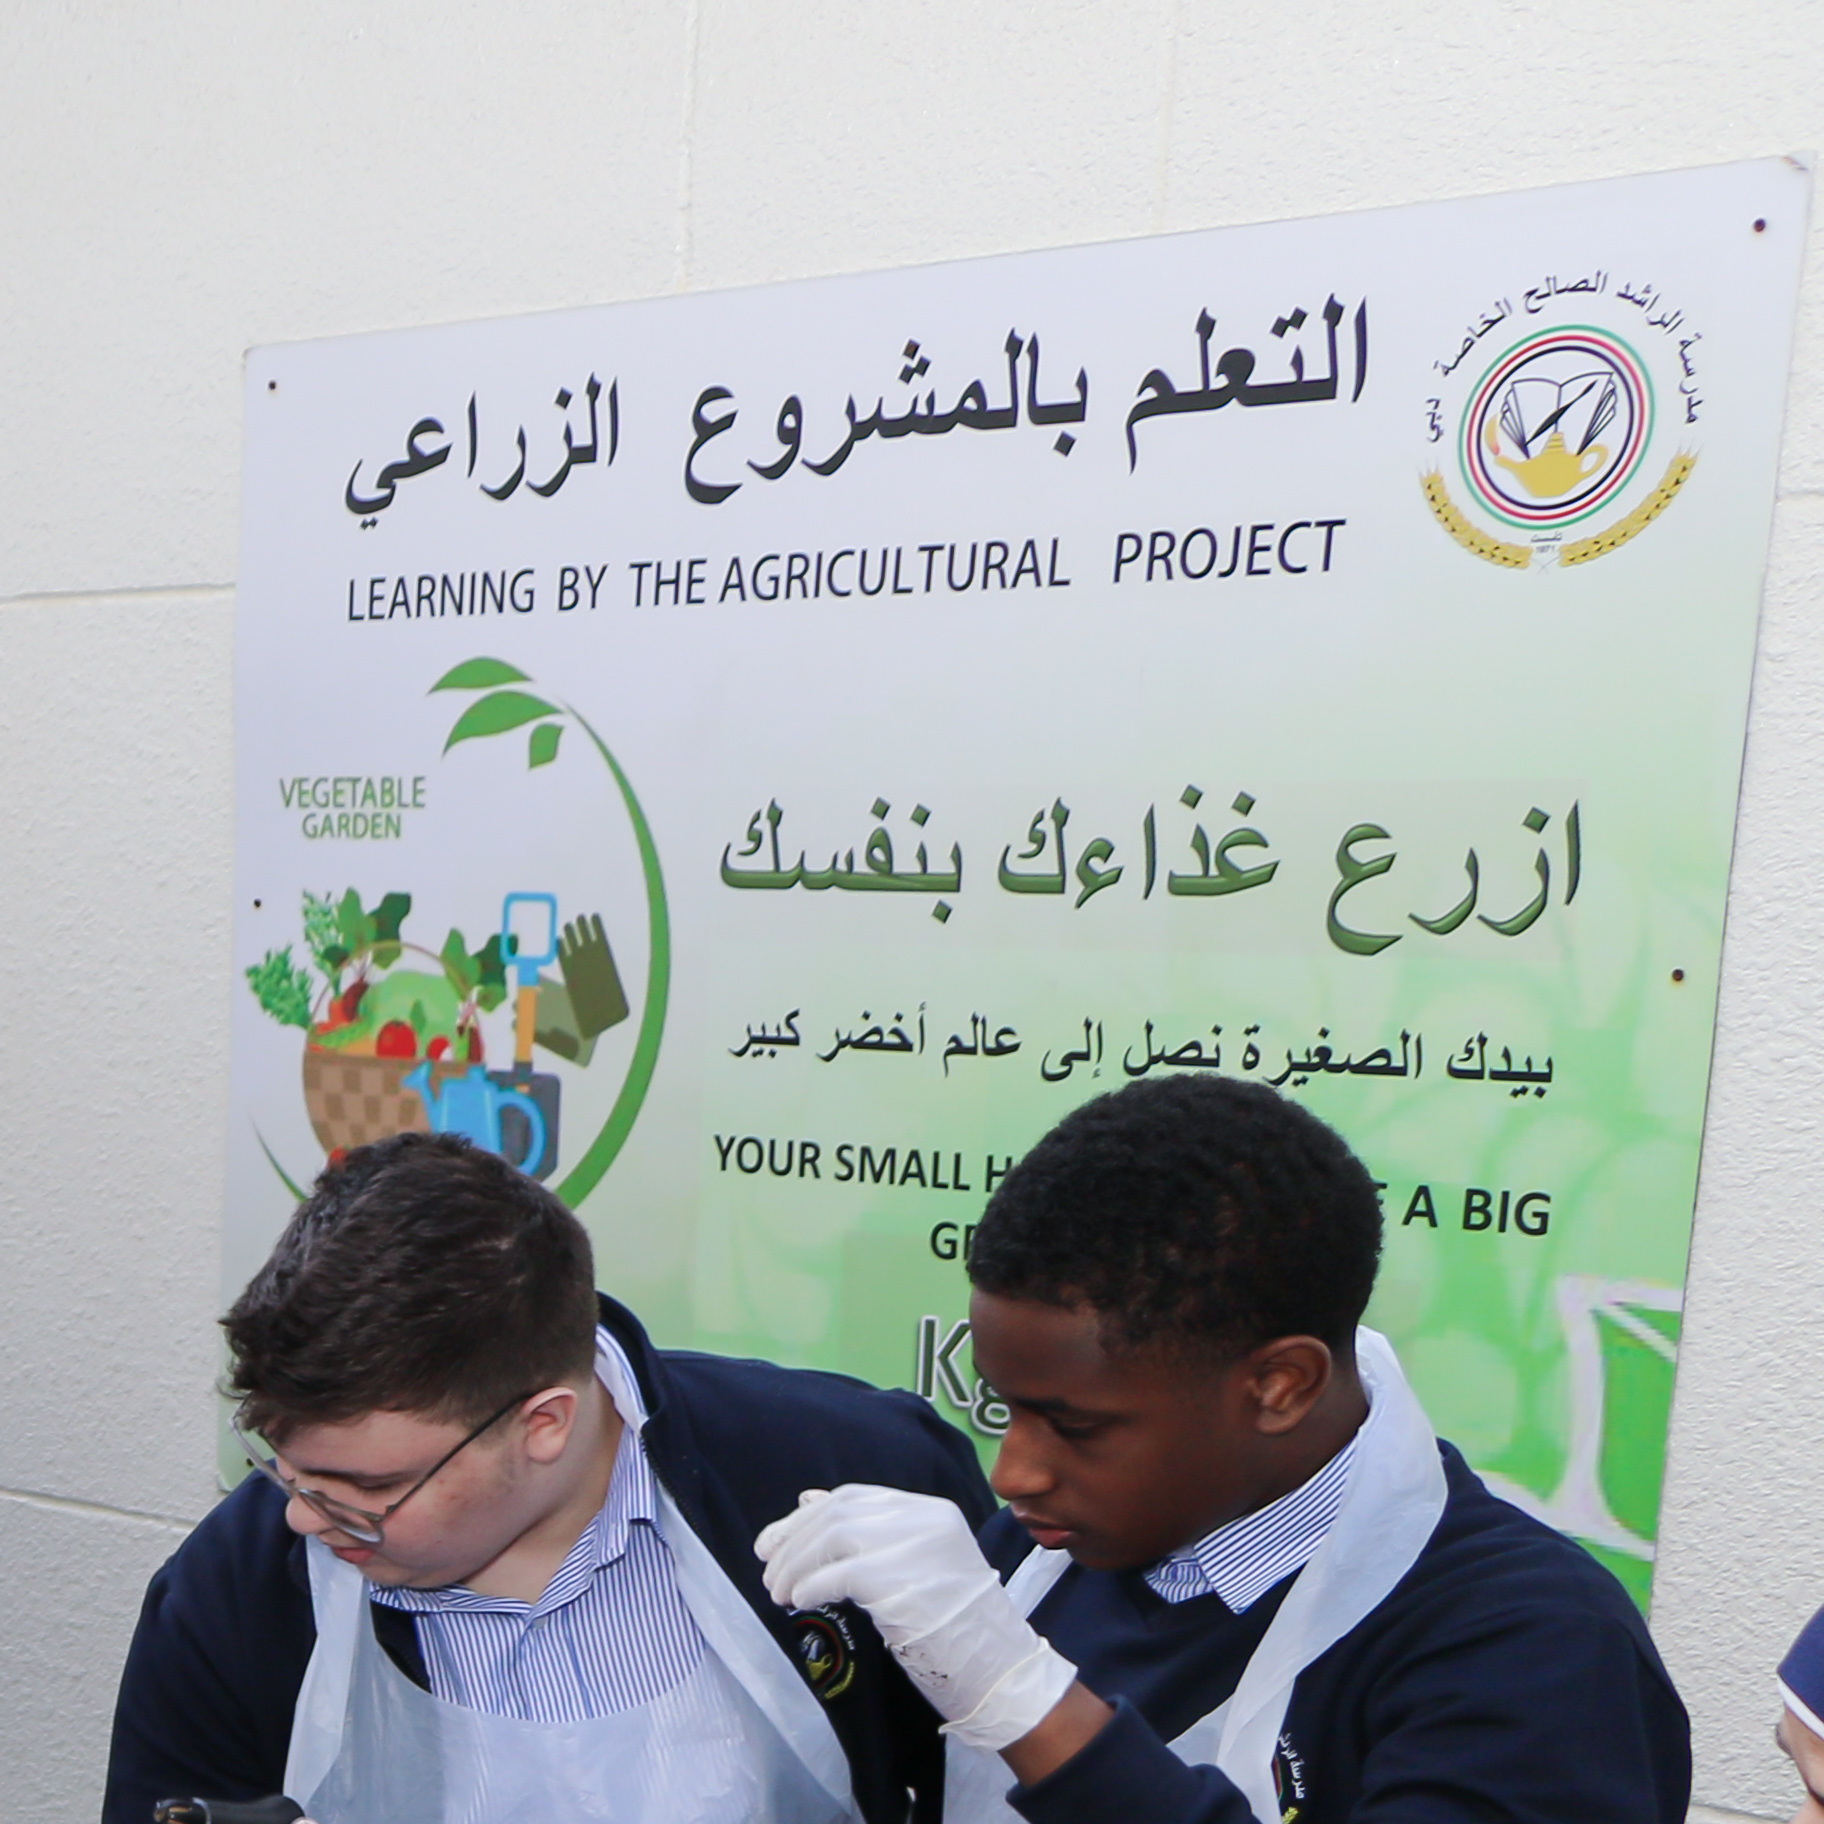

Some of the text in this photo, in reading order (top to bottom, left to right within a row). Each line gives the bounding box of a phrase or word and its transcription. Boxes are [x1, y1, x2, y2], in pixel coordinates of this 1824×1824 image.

[1425, 270, 1703, 443] مدرسة الراشد الصالح الخاصة دبي
[345, 292, 1368, 530] التعلم بالمشروع الزراعي
[347, 517, 1348, 622] LEARNING BY THE AGRICULTURAL PROJECT
[279, 776, 426, 808] VEGETABLE
[302, 812, 401, 839] GARDEN
[720, 784, 1581, 956] ازرع غذاءك بنفسك
[728, 1001, 1554, 1099] بيدك الصغيرة نصل إلى عالم أخضر كبير
[714, 1134, 821, 1179] YOUR
[834, 1144, 970, 1191] SMALL
[1402, 1184, 1439, 1228] A
[1462, 1188, 1552, 1236] BIG
